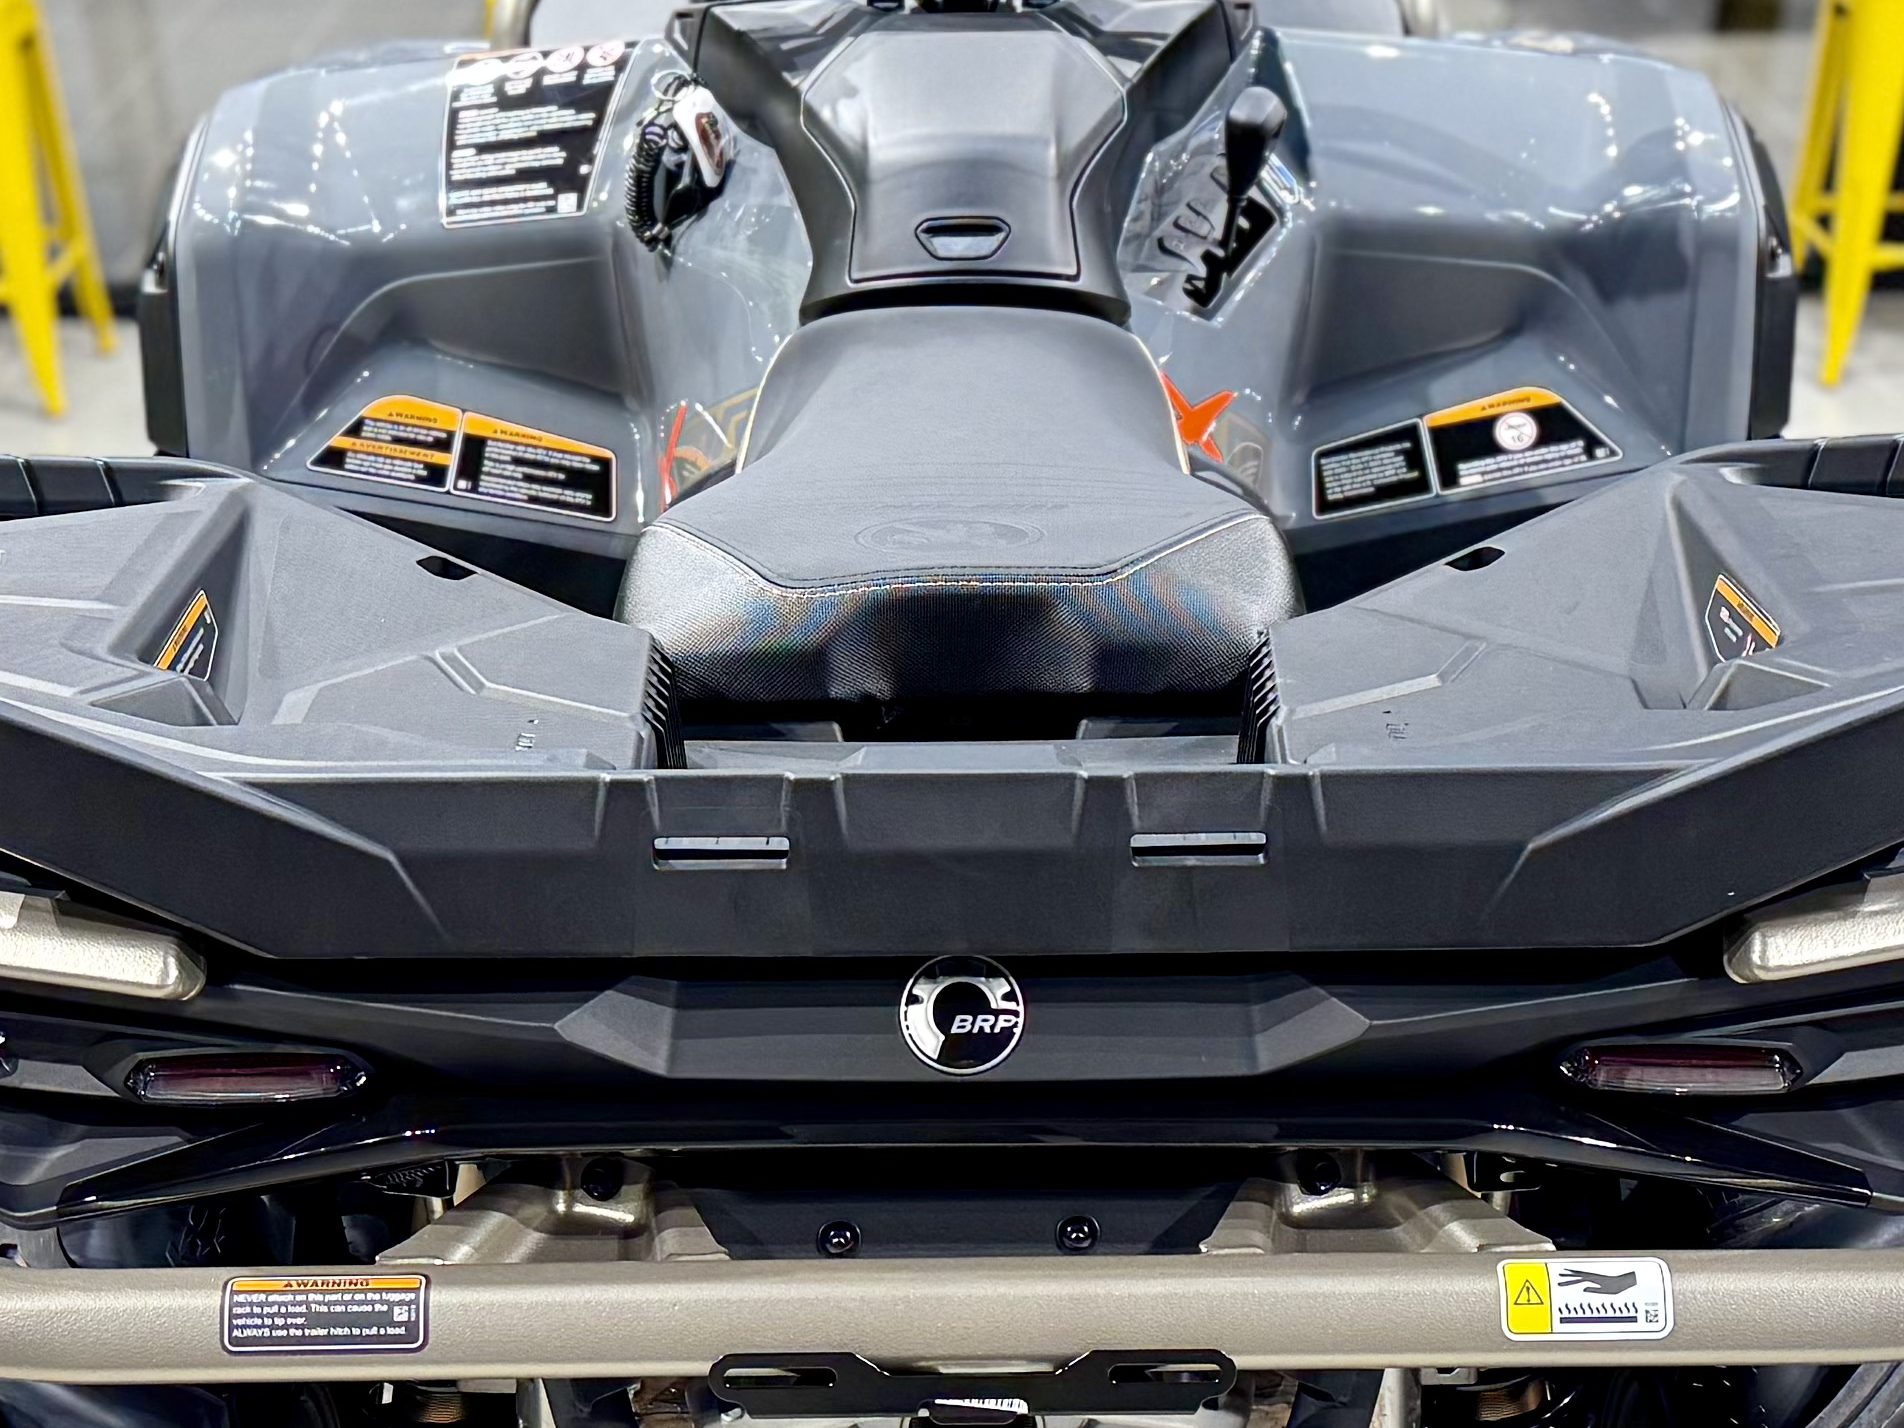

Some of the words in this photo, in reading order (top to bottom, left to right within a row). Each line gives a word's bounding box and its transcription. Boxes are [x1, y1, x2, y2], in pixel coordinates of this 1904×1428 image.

[950, 1014, 1015, 1034] BRP
[296, 1278, 370, 1288] WARNING
[233, 1293, 267, 1302] NEVER
